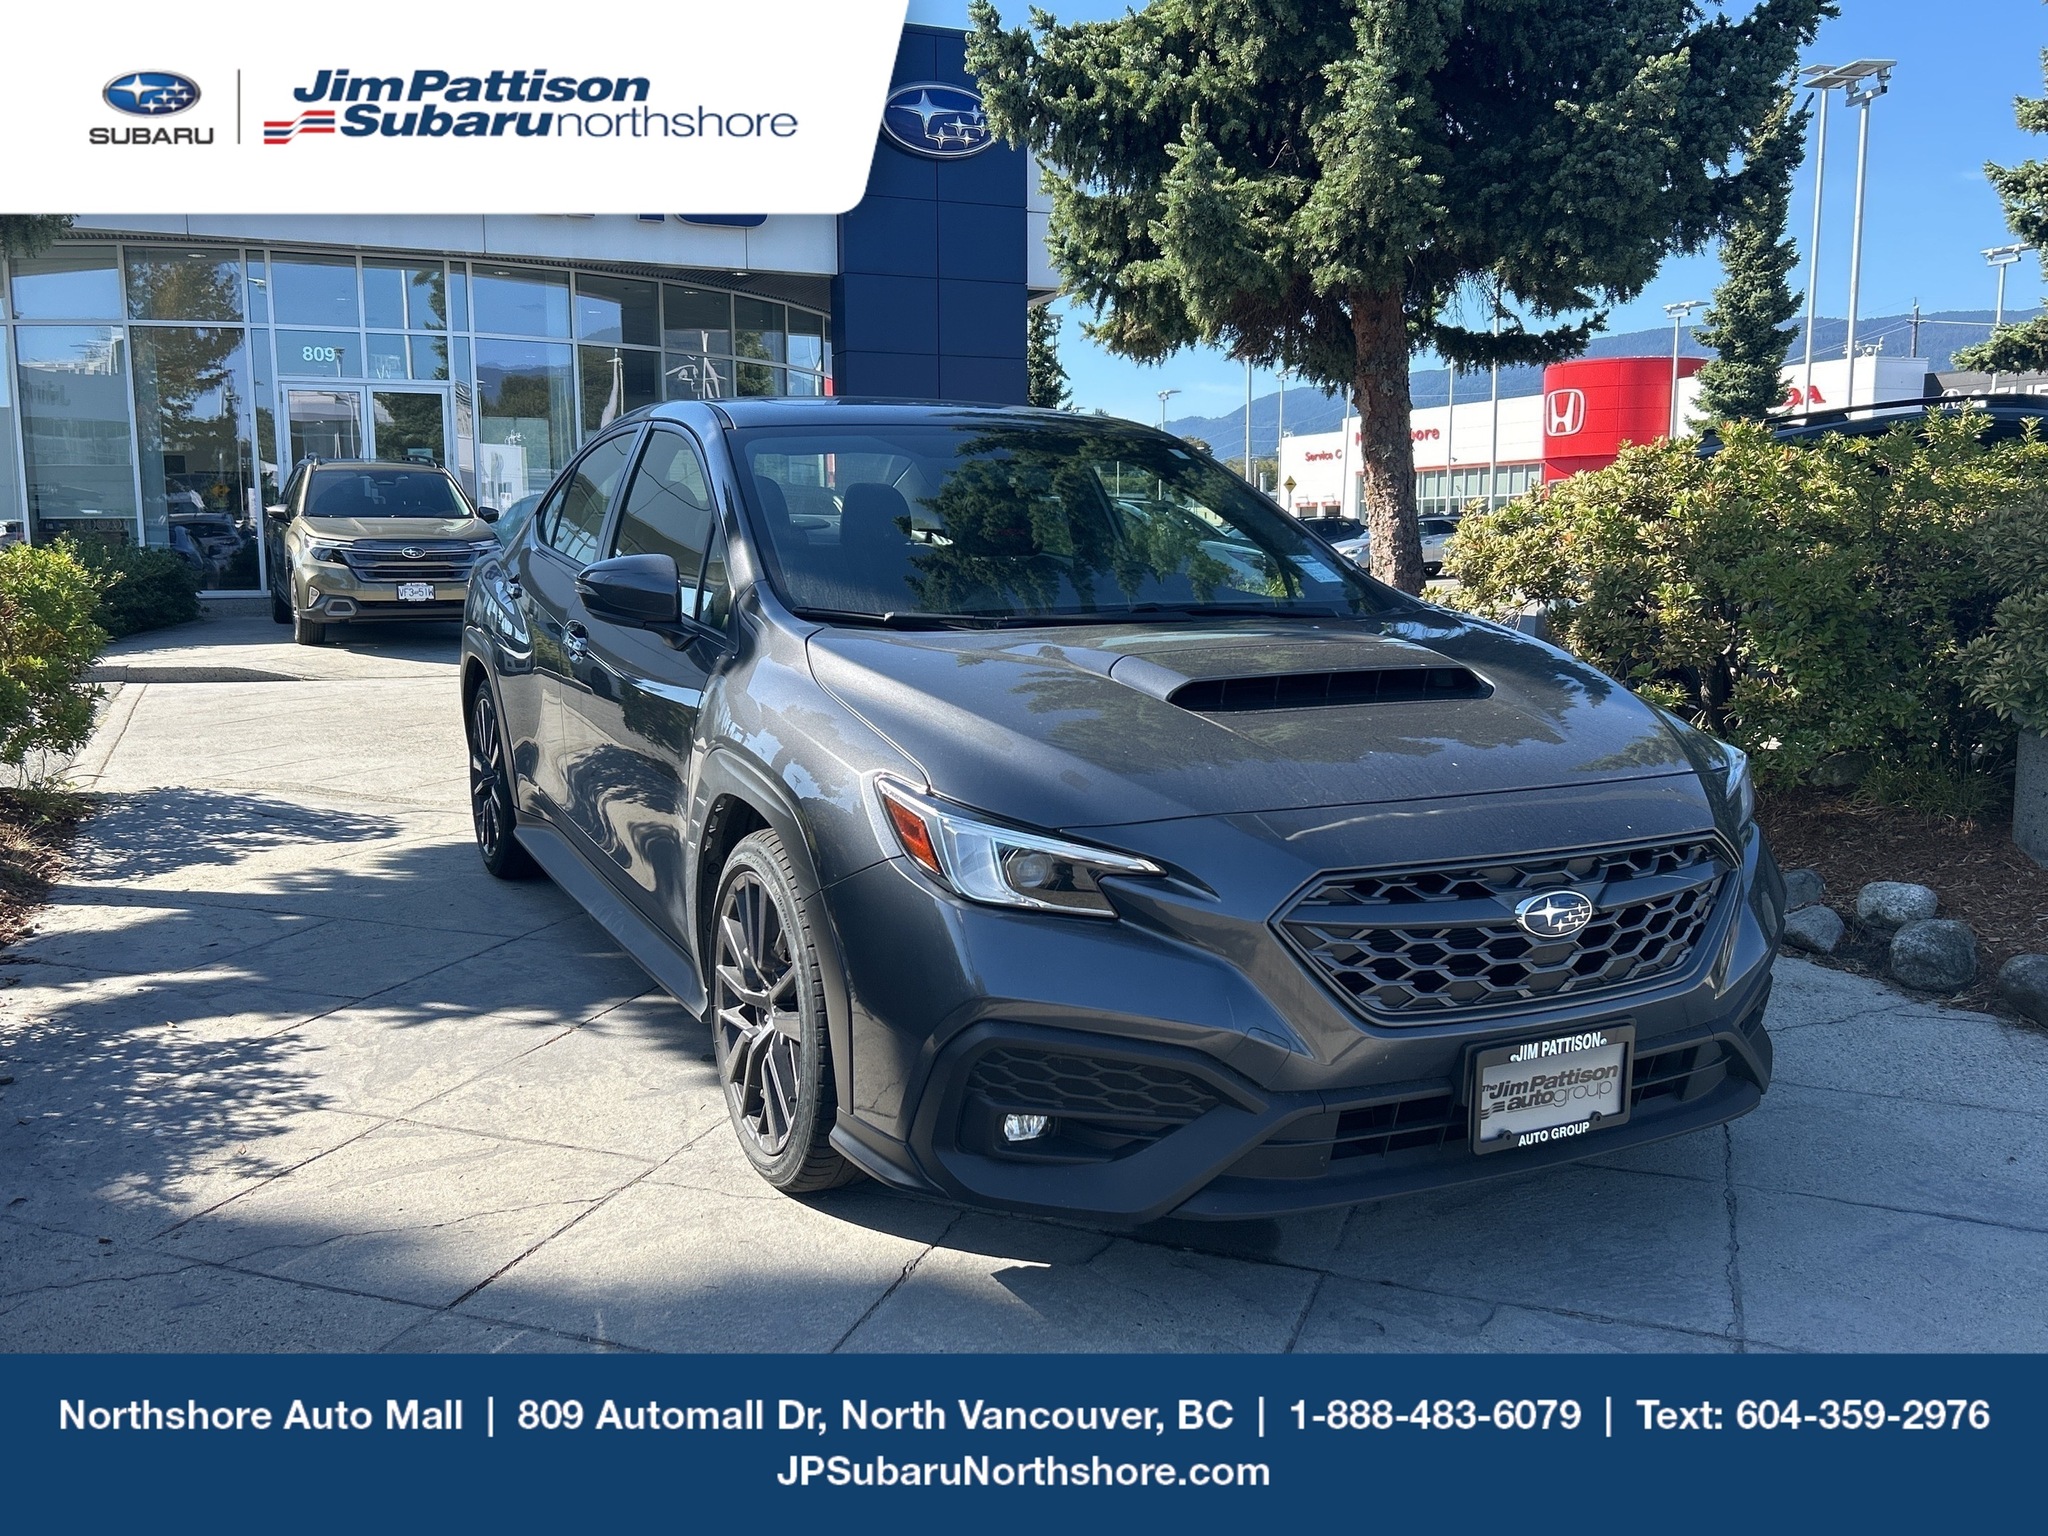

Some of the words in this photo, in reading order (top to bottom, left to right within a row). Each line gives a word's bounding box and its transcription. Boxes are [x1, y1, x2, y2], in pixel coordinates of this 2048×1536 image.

[302, 346, 336, 362] 809
[1305, 450, 1334, 462] Service
[1516, 1042, 1539, 1062] JIM
[1541, 1031, 1602, 1057] PATTISON
[1481, 1082, 1498, 1093] The
[1529, 1064, 1619, 1093] Pattison
[1489, 1080, 1531, 1100] Jim
[1517, 1130, 1549, 1147] AUTO
[1550, 1121, 1590, 1140] GROUP
